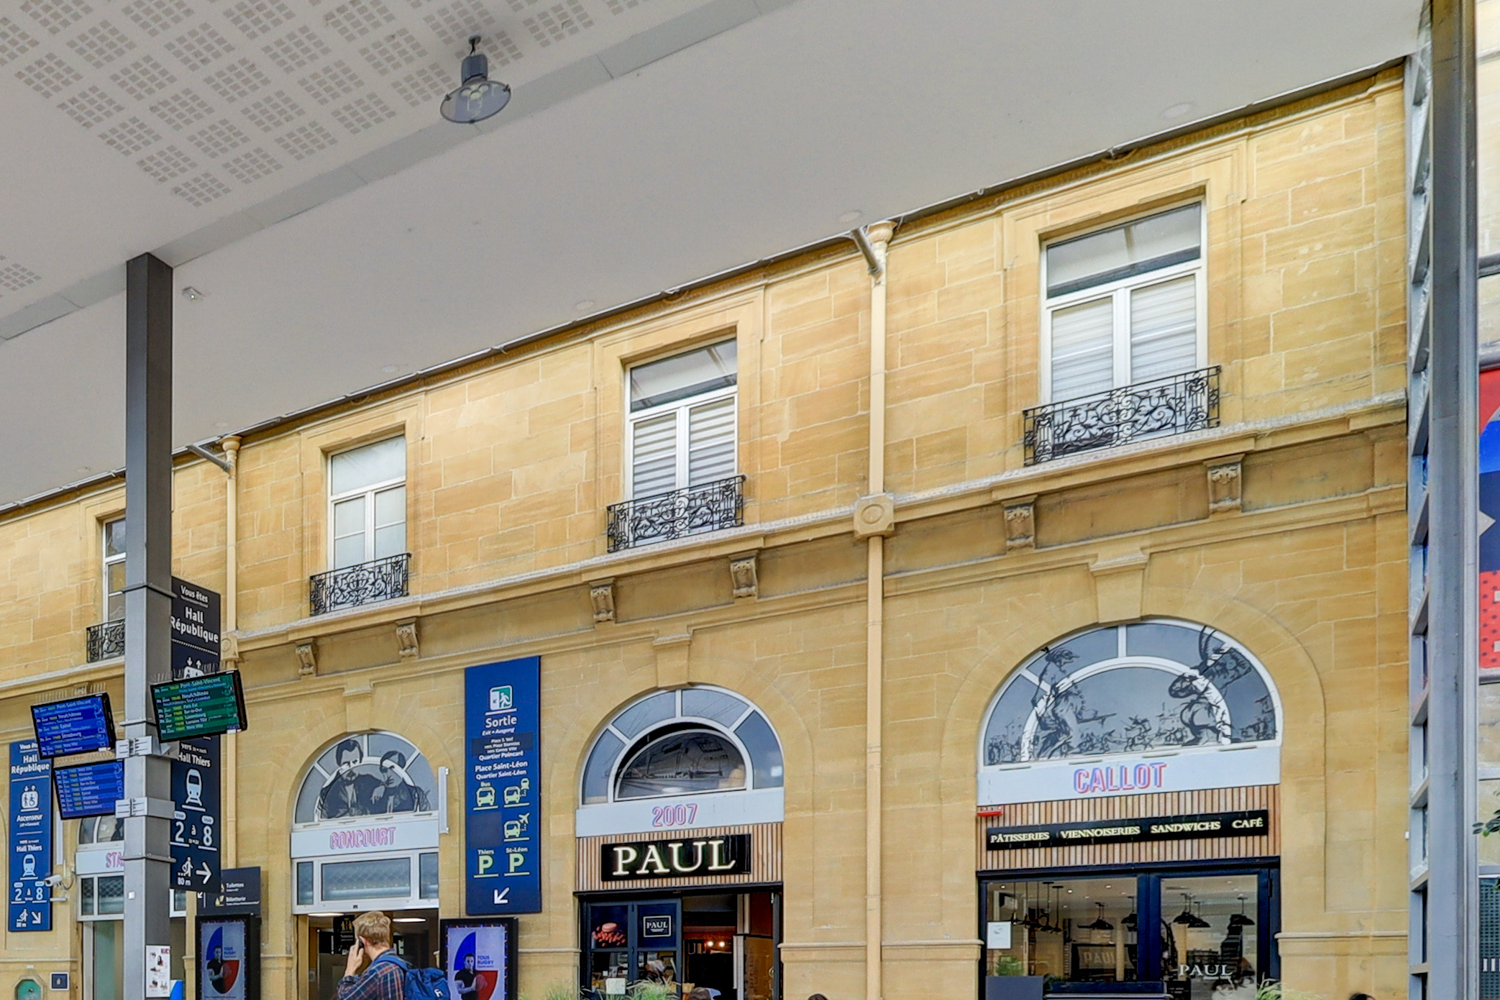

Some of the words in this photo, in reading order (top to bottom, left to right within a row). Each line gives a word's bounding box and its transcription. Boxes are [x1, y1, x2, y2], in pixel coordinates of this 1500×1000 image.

[180, 585, 195, 598] Vous
[196, 591, 208, 602] êtes
[185, 607, 204, 624] Hall
[170, 616, 218, 643] République
[485, 715, 517, 728] Sortie
[23, 754, 38, 763] Hall
[191, 754, 211, 767] Thiers
[479, 753, 500, 761] Quartier
[501, 750, 524, 758] Poincaré
[11, 763, 50, 775] République
[475, 764, 492, 772] Place
[493, 761, 528, 771] Saint-Léon
[476, 772, 498, 780] Quartier
[498, 770, 527, 778] Saint-Léon
[1073, 762, 1168, 794] CALLOT
[652, 803, 698, 827] 2007
[175, 821, 185, 842] 2
[203, 825, 212, 846] 8
[990, 831, 1050, 844] PÂTISSERIES
[1060, 826, 1141, 840] VIENNOISERIES
[1150, 821, 1221, 834] SANDWICHS
[1232, 817, 1264, 829] CAFÉ
[330, 827, 396, 850] GONCOURT
[478, 855, 493, 874] P
[509, 853, 524, 872] P
[612, 839, 736, 876] PAUL
[15, 888, 22, 901] 2
[36, 887, 43, 900] 8
[647, 921, 668, 929] PAUL
[1179, 964, 1234, 977] PAUL
